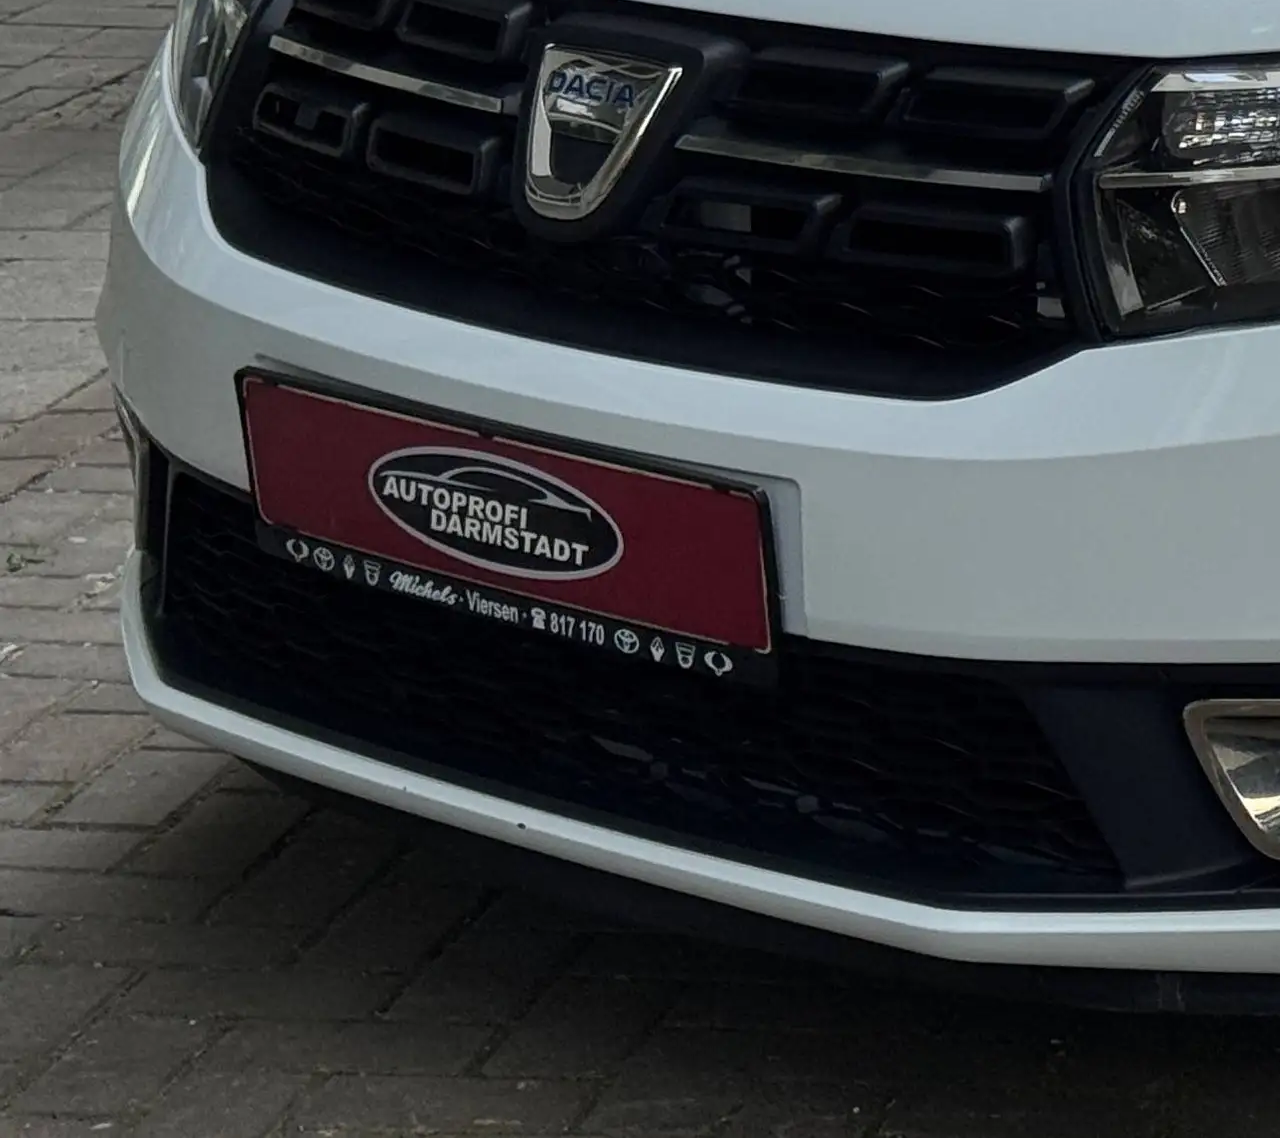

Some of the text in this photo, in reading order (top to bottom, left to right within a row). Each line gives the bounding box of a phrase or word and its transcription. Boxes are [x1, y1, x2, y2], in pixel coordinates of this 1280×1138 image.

[547, 70, 634, 108] DACIA
[383, 476, 528, 529] AUTOPROFI
[431, 509, 589, 565] DARMSTADT
[390, 571, 605, 645] Michels Viersen 817 170
